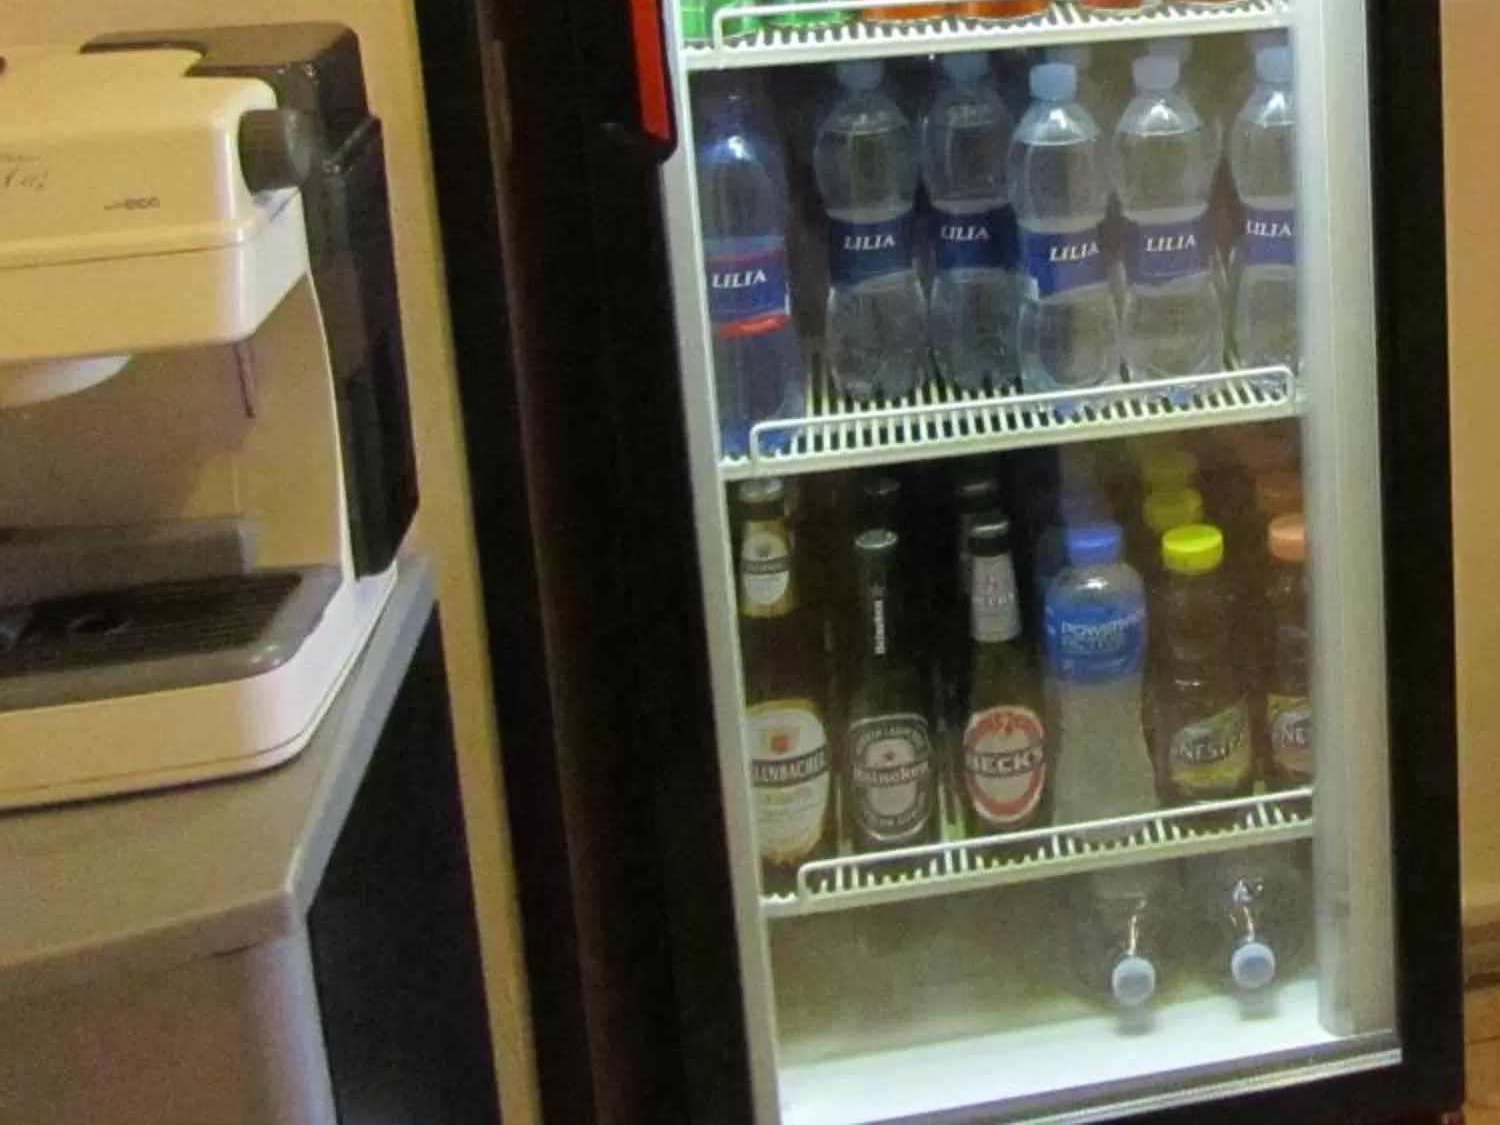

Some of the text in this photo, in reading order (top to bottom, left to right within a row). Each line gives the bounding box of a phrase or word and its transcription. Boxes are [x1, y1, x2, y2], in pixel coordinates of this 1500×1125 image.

[940, 225, 990, 241] LILIA
[1246, 220, 1292, 237] LILIA
[844, 233, 896, 252] LILIA
[1050, 240, 1100, 262] LILIA
[1147, 234, 1196, 252] LILIA
[711, 269, 767, 289] LILIA
